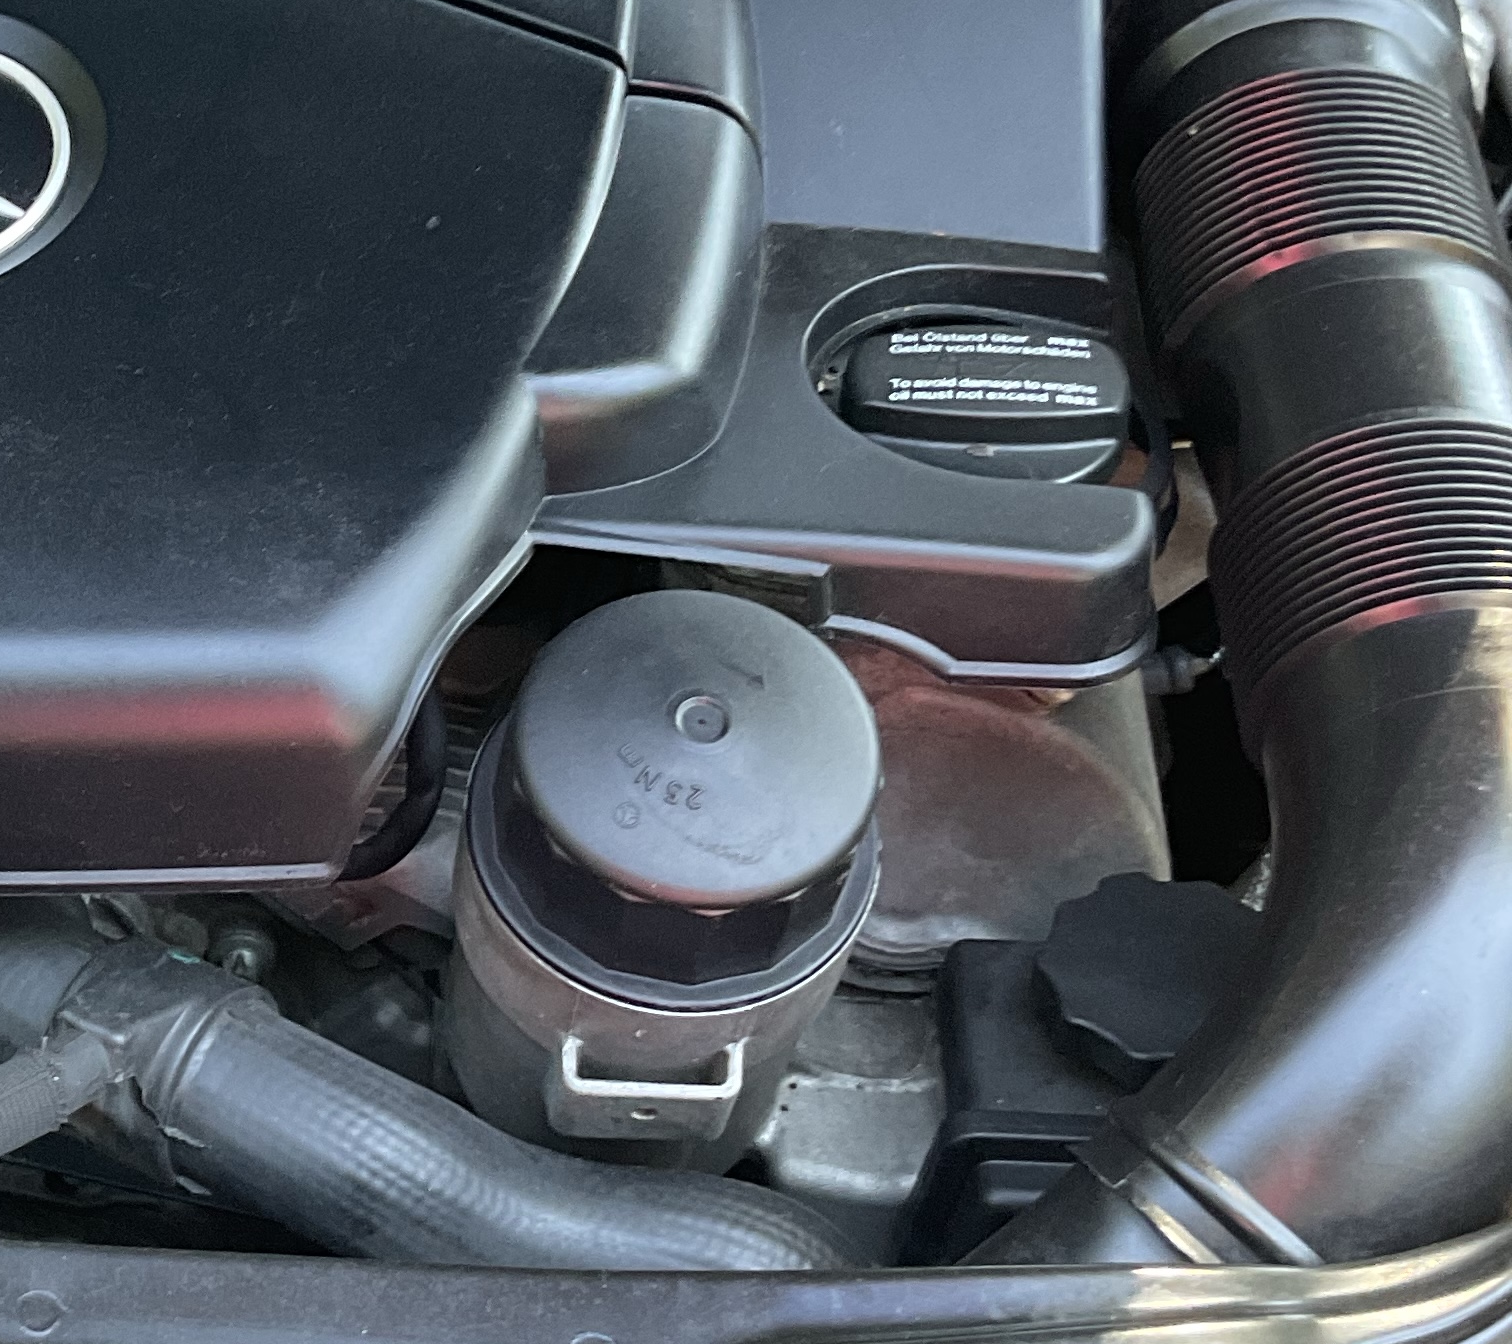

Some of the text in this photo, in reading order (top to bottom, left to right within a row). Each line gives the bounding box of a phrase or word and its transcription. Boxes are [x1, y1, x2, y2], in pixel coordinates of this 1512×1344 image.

[888, 378, 912, 389] To
[913, 377, 957, 388] avoid
[958, 377, 1023, 390] damage
[912, 390, 953, 400] must
[955, 390, 984, 400] not
[985, 392, 1050, 403] exceed
